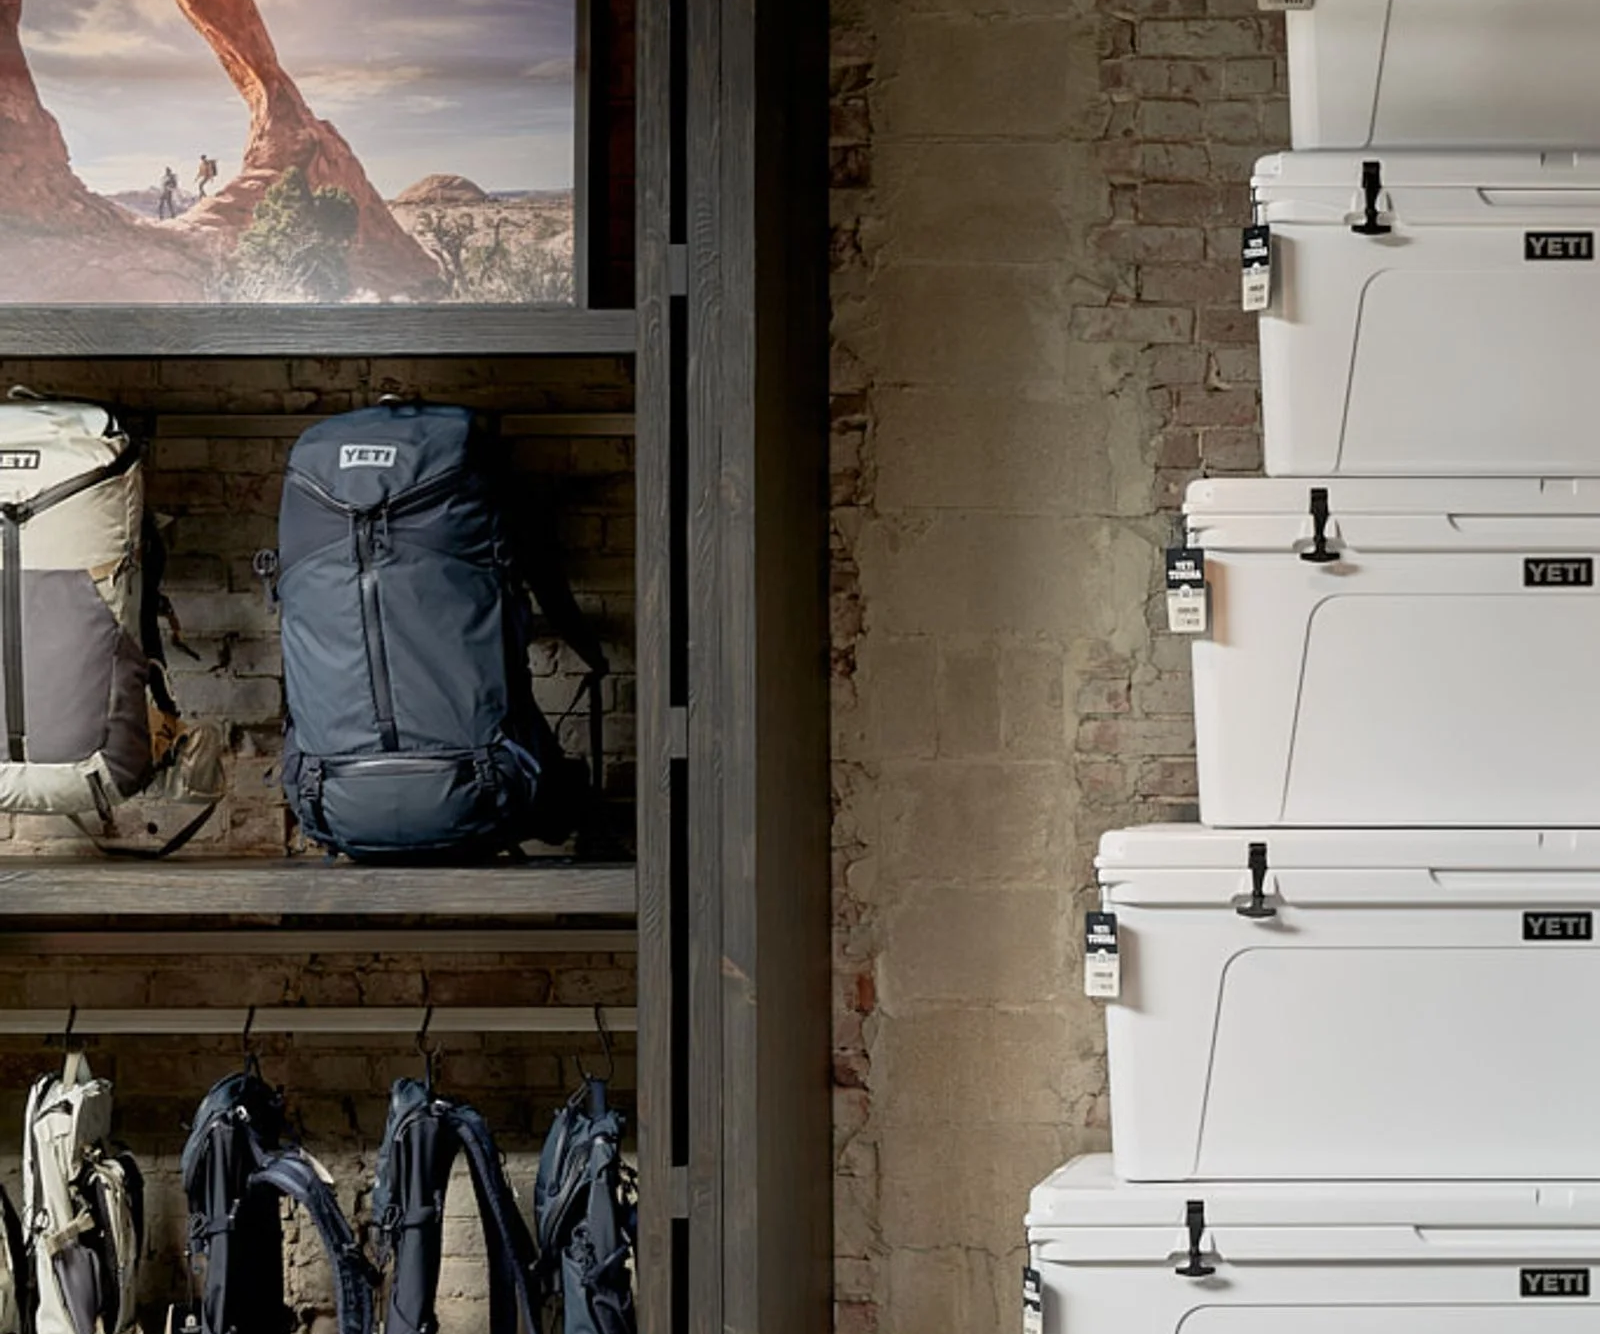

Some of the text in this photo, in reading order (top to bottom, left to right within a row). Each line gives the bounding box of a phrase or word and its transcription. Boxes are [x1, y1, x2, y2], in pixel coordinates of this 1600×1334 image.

[1529, 237, 1587, 256] YETI
[0, 454, 36, 467] ETI
[343, 449, 391, 463] YETI
[1527, 563, 1587, 582] YETI
[1527, 917, 1587, 936] YETI
[1524, 1273, 1584, 1292] YETI
